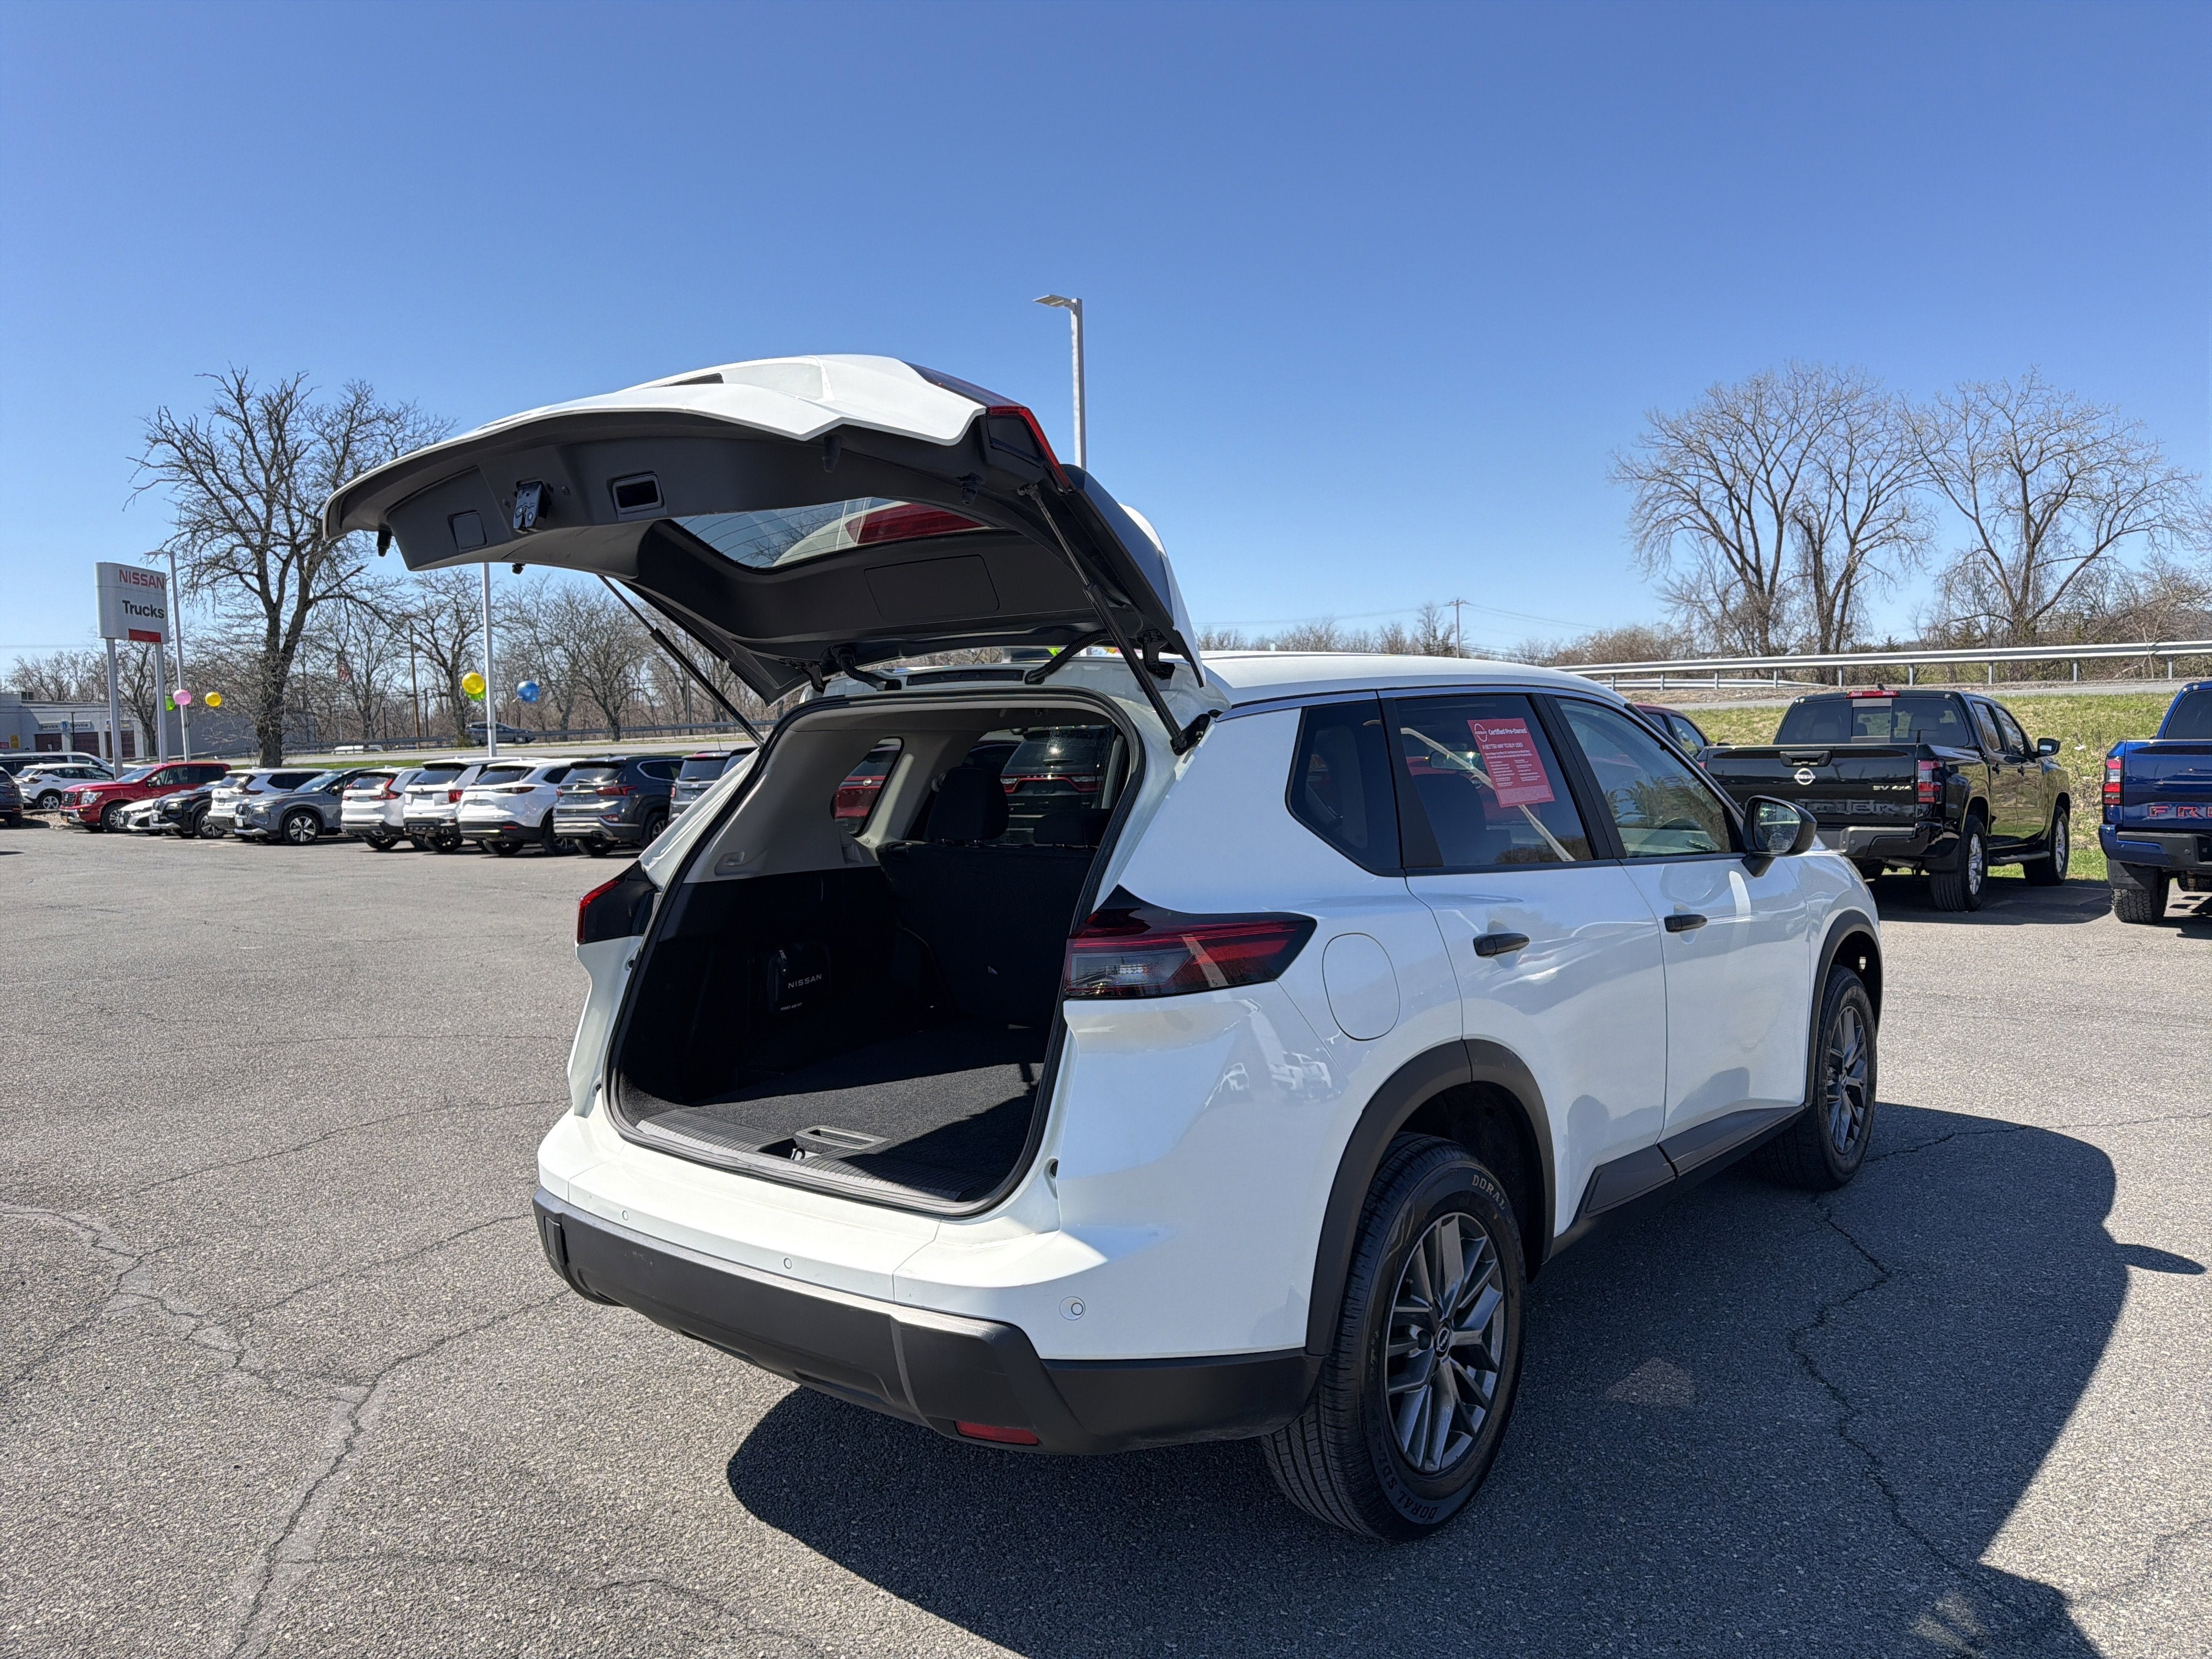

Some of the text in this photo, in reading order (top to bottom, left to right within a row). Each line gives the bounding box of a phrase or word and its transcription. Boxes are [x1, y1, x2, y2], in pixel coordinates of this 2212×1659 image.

[119, 569, 165, 590] NISSAN
[122, 599, 165, 619] Trucks
[2149, 805, 2212, 818] FR
[788, 973, 822, 989] NISSAN
[1397, 1491, 1439, 1519] DORAL
